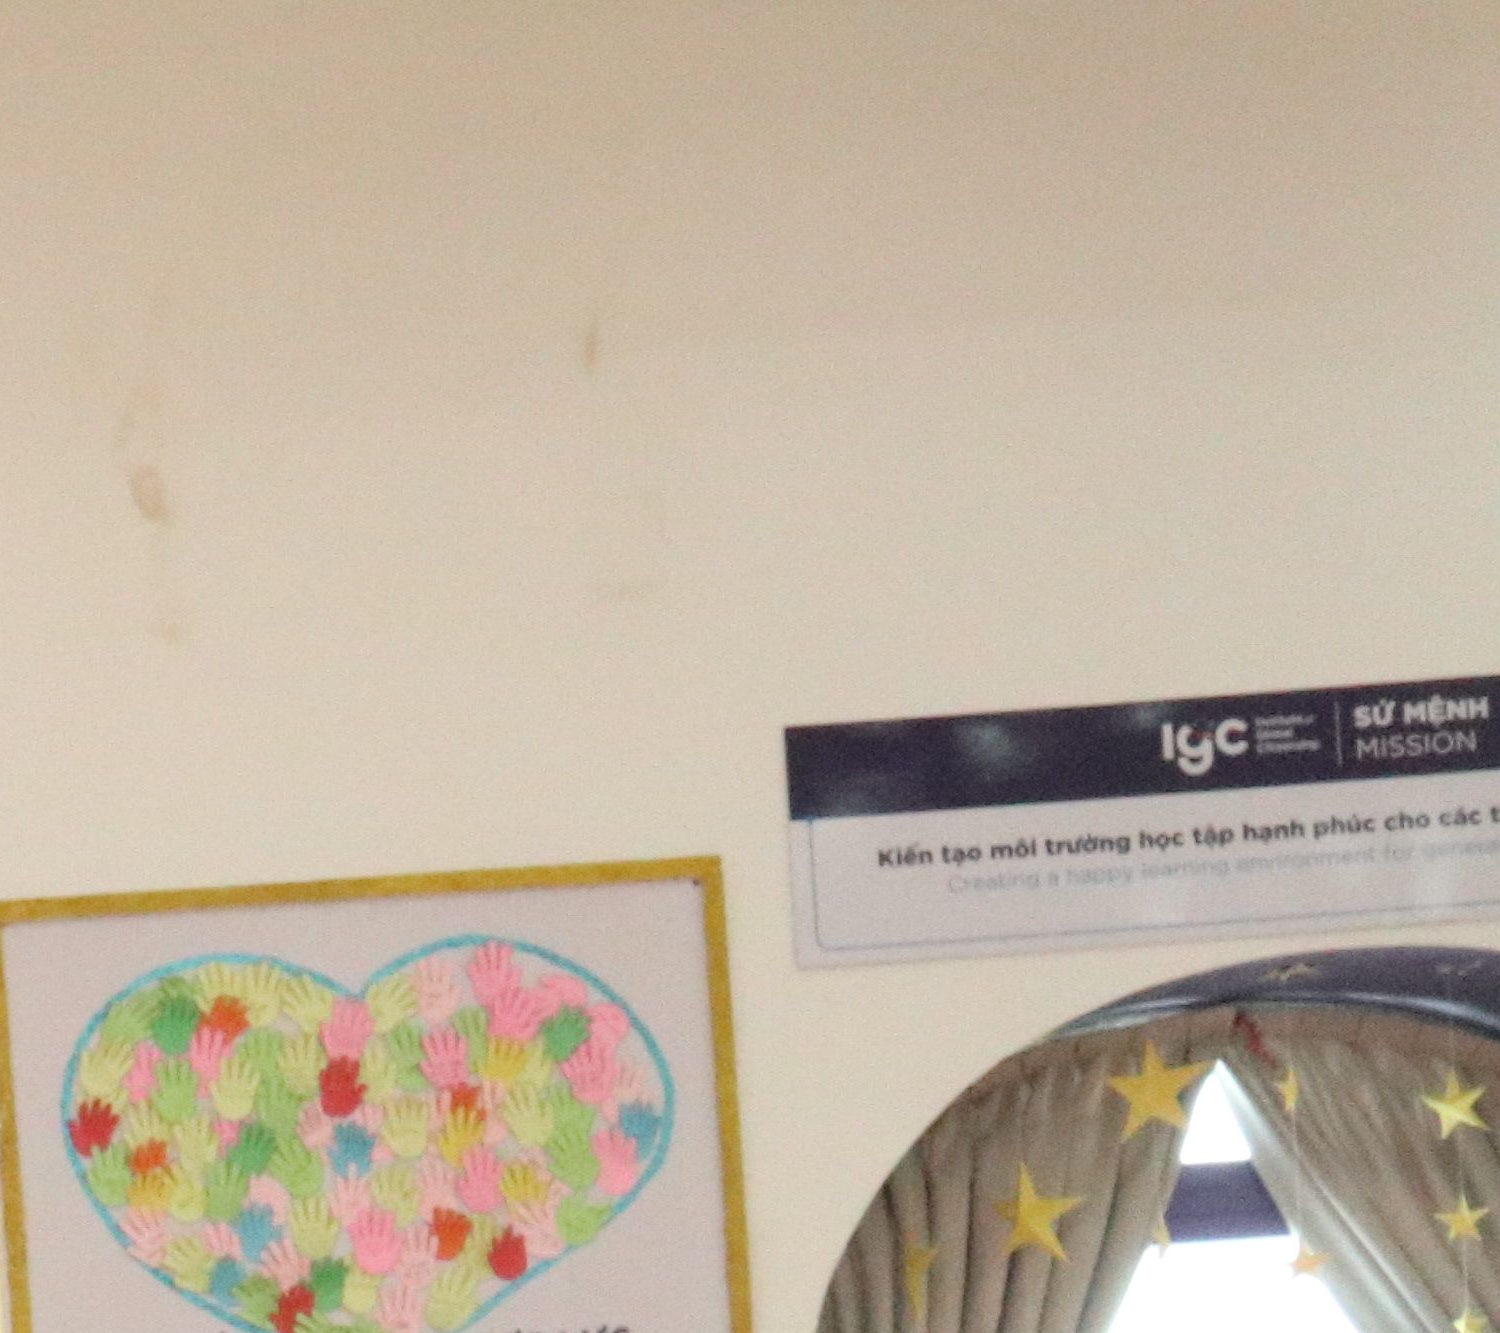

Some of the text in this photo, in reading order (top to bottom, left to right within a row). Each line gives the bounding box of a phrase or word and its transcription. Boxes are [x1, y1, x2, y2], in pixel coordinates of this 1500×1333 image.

[1354, 693, 1490, 729] SỨ MỆNH
[1354, 729, 1478, 759] MISSION
[941, 845, 983, 866] tạo
[990, 837, 1038, 860] môi
[1045, 833, 1132, 858] trường
[1139, 827, 1185, 851] học
[1243, 820, 1306, 844] hạnh
[1312, 813, 1376, 841] phúc
[1383, 810, 1431, 832] cho
[1438, 805, 1482, 826] các
